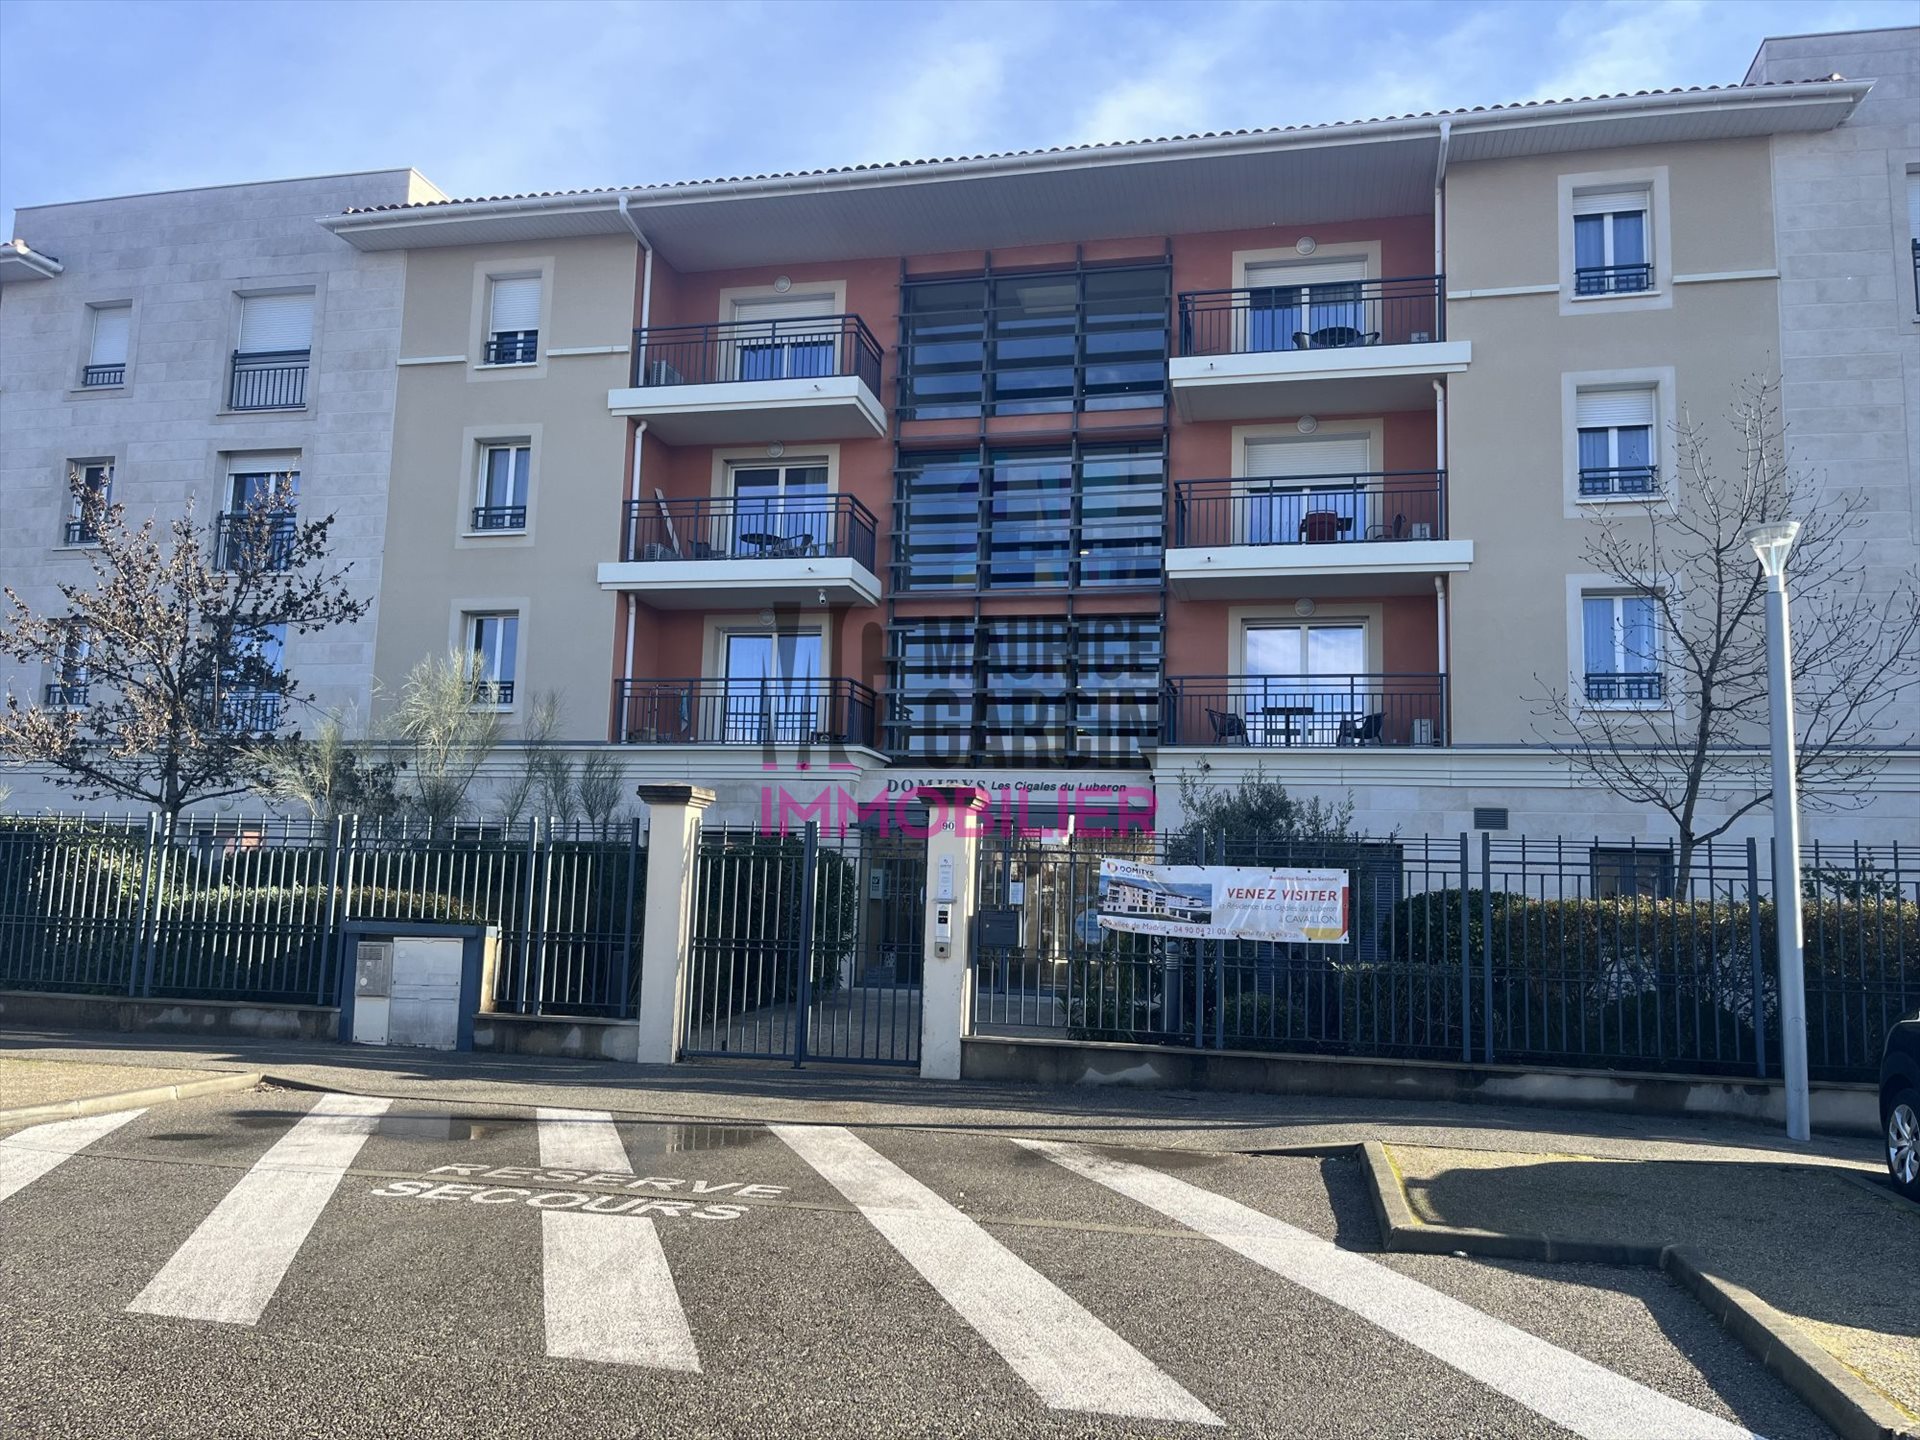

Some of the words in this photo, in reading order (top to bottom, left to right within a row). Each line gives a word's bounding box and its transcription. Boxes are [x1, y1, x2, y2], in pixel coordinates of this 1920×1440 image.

[991, 781, 1010, 791] Les
[1014, 781, 1056, 793] Cigales
[1060, 782, 1074, 791] du
[1078, 782, 1126, 792] Luberon
[942, 822, 954, 830] 90
[1227, 888, 1276, 900] VENEZ
[1282, 889, 1337, 901] VISITER
[1261, 902, 1272, 911] Les
[1285, 915, 1337, 924] CAVAILLON
[1173, 925, 1182, 933] 04
[1185, 926, 1193, 934] 90
[371, 1181, 749, 1220] SECOURS
